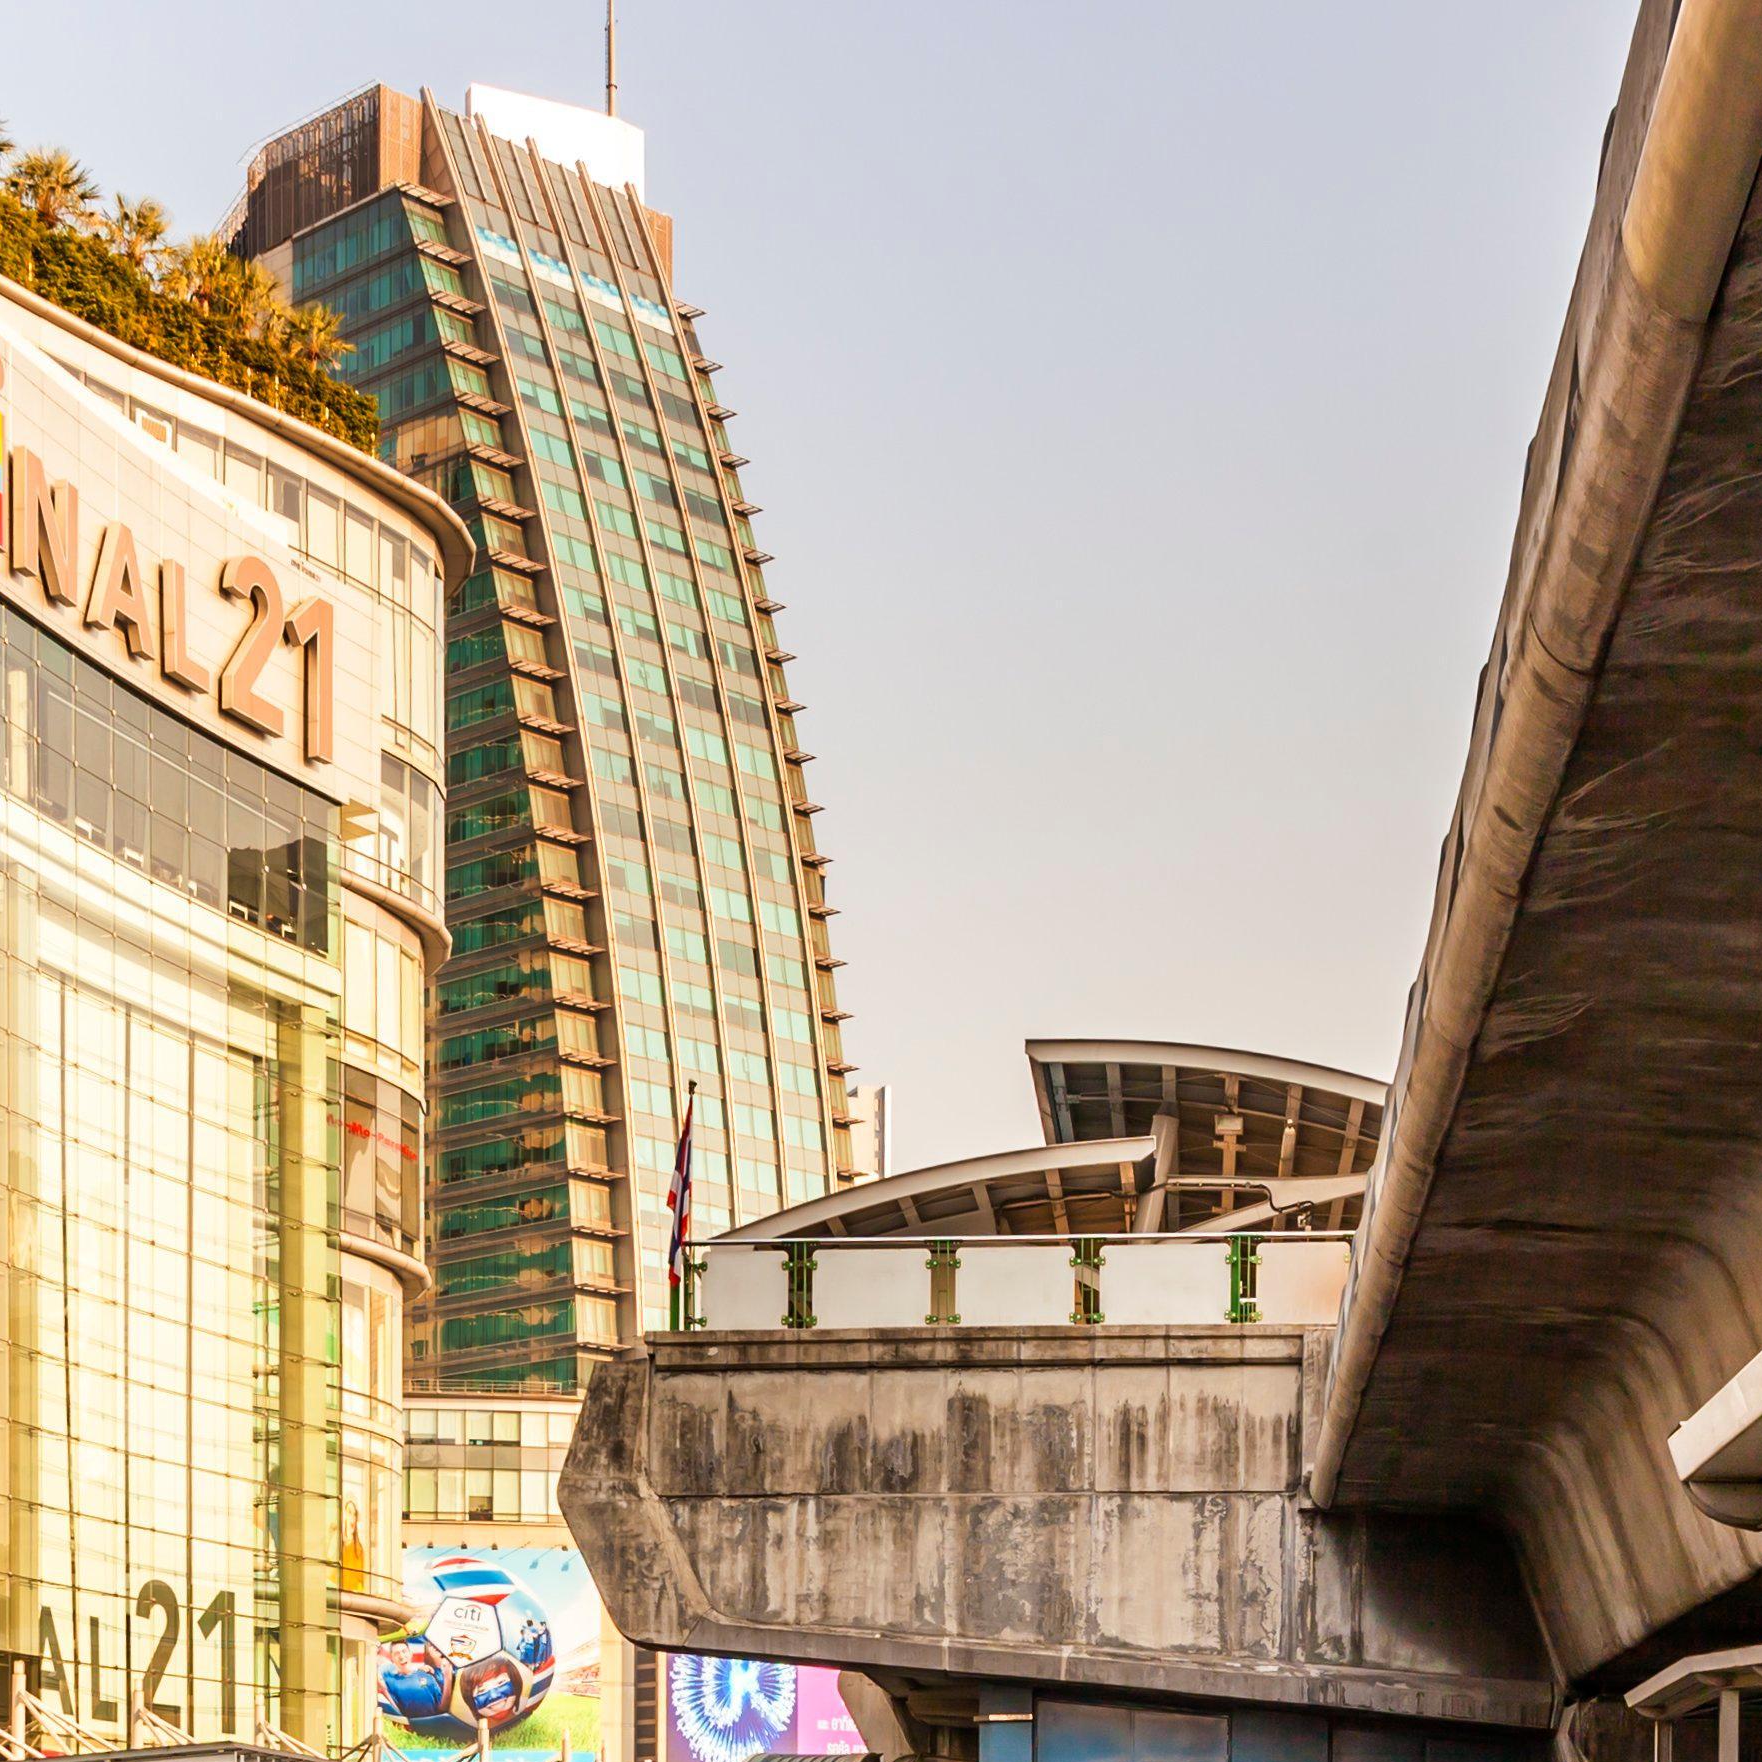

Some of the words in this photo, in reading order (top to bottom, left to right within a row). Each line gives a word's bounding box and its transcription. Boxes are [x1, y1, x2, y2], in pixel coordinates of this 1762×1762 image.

[221, 555, 334, 766] 21
[135, 1580, 237, 1735] 21
[454, 1604, 481, 1621] citi
